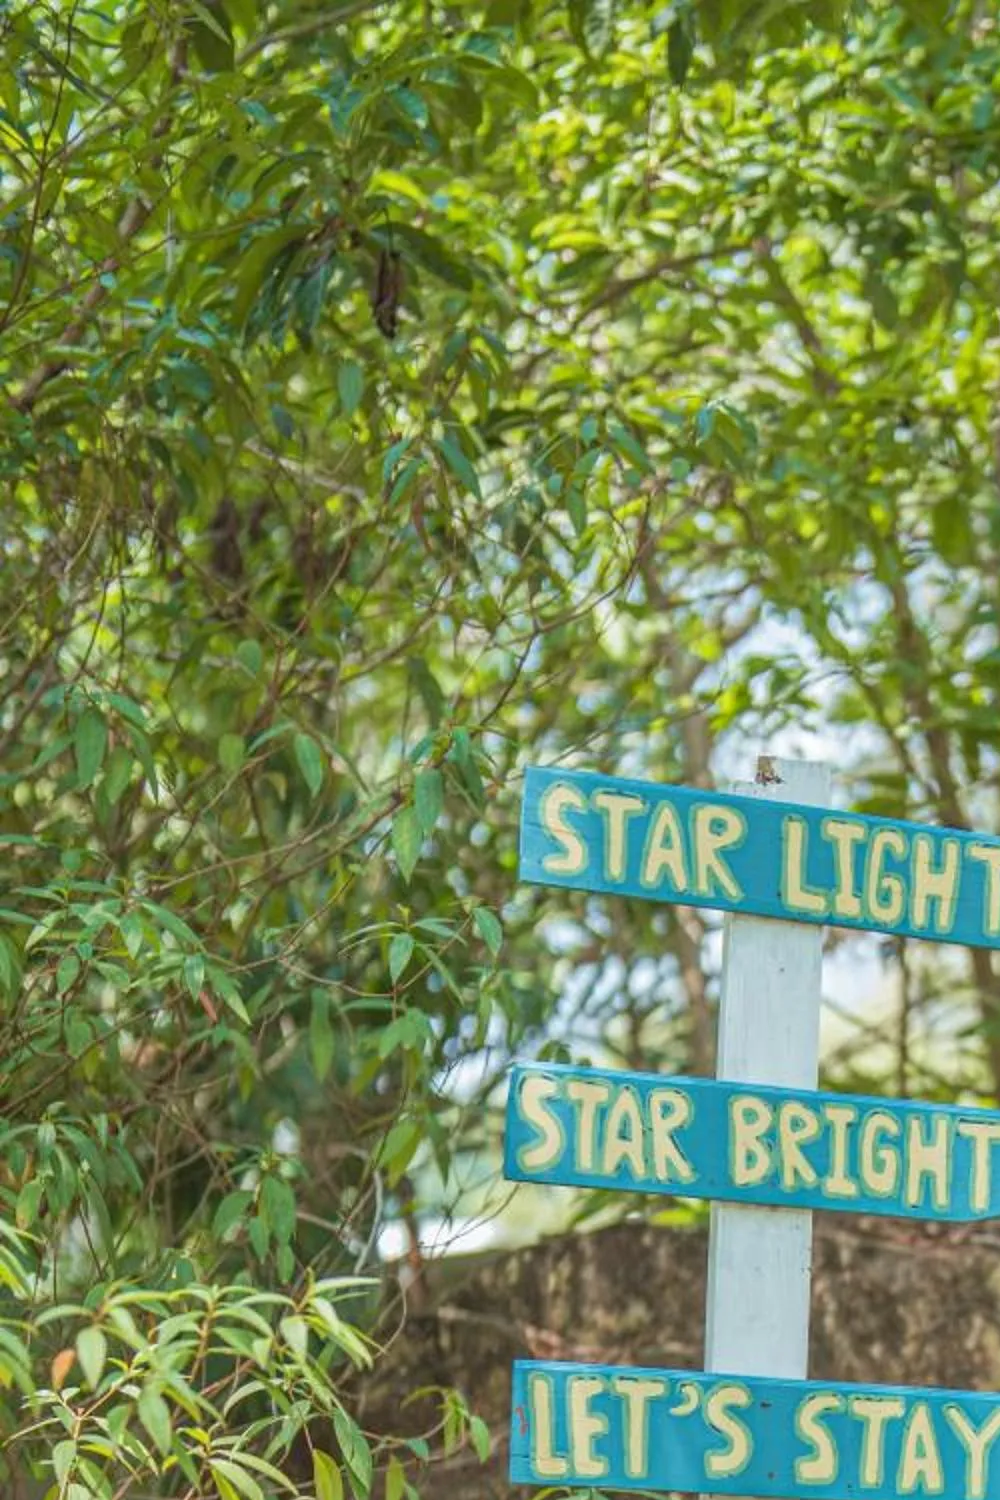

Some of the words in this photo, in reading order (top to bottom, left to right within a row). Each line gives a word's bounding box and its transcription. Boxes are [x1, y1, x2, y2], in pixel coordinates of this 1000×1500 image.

[540, 782, 748, 901] STAR
[517, 1072, 698, 1184] STAR
[528, 1370, 754, 1481] LET'S
